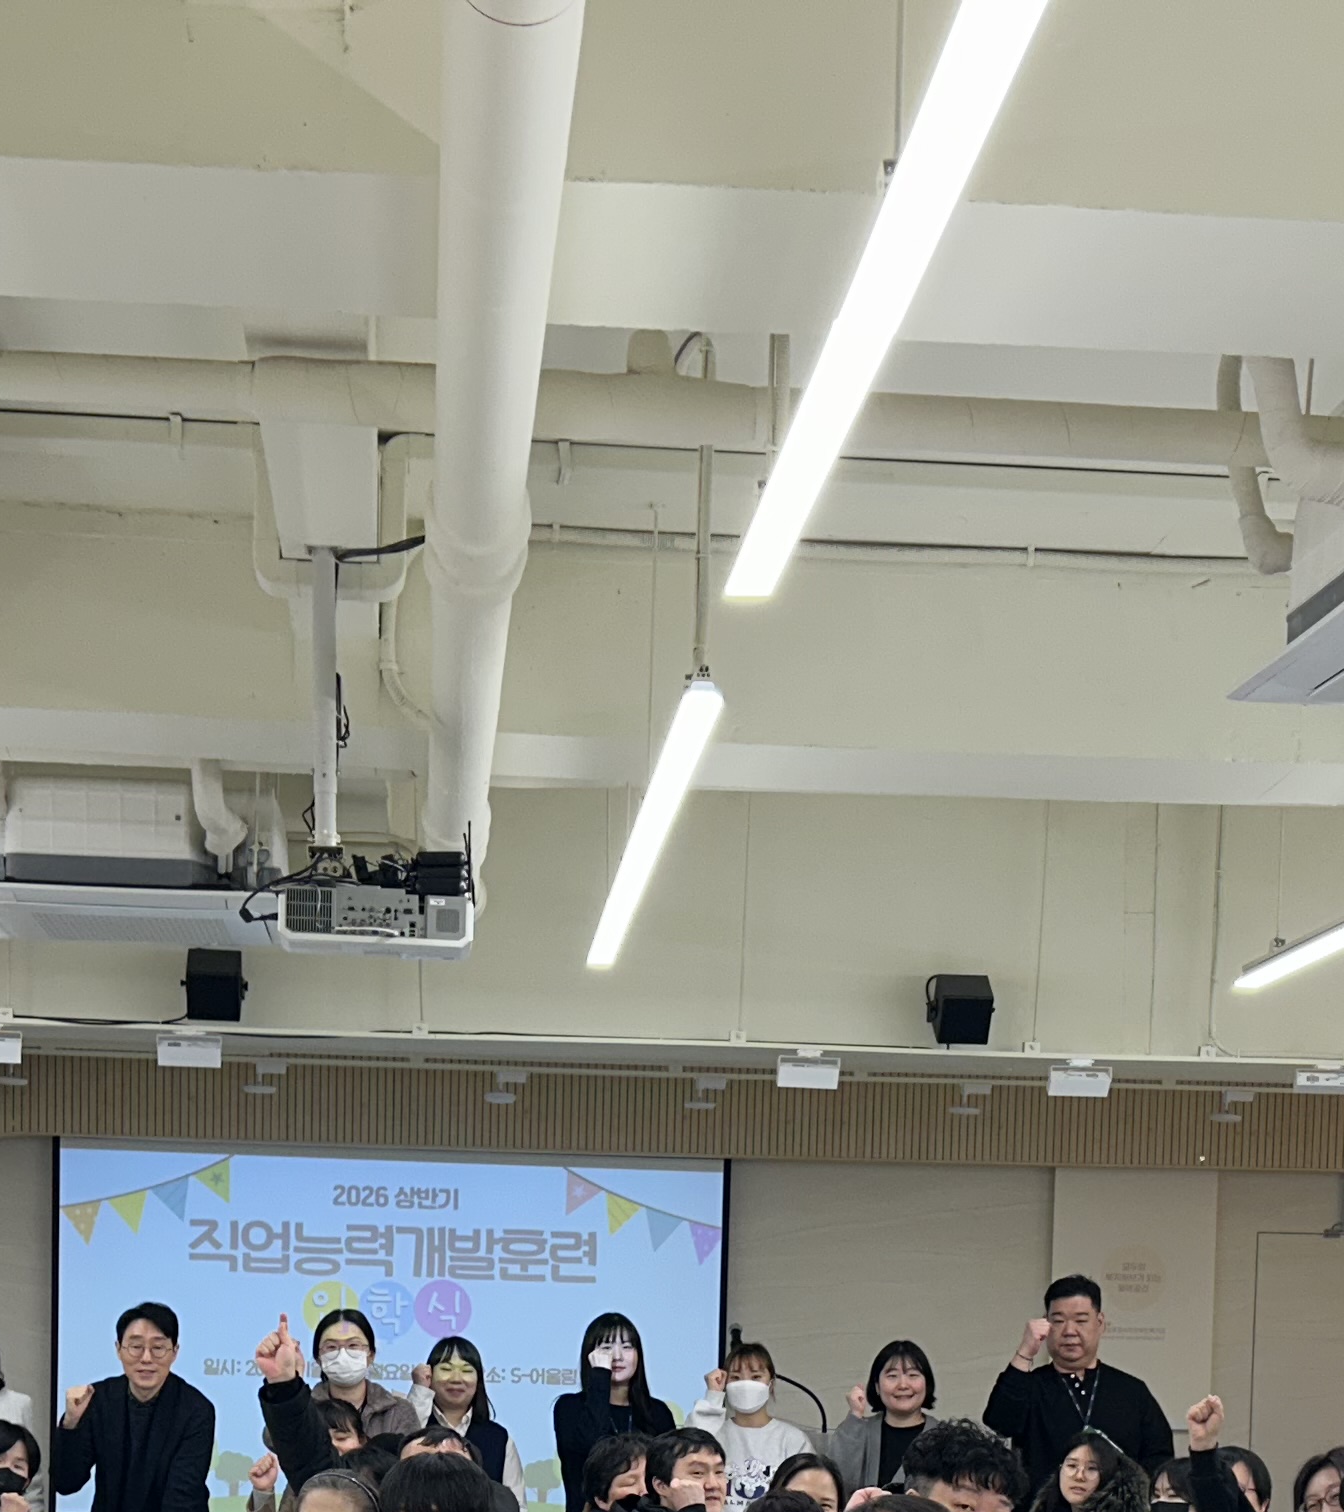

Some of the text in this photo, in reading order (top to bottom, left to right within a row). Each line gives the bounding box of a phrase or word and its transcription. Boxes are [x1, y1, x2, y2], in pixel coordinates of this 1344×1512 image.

[333, 1185, 459, 1211] 2026 상반기
[188, 1218, 597, 1284] 직업능력개발훈련
[203, 1358, 242, 1377] 일시:
[485, 1366, 506, 1384] 소:
[510, 1367, 577, 1386] S-어울림
